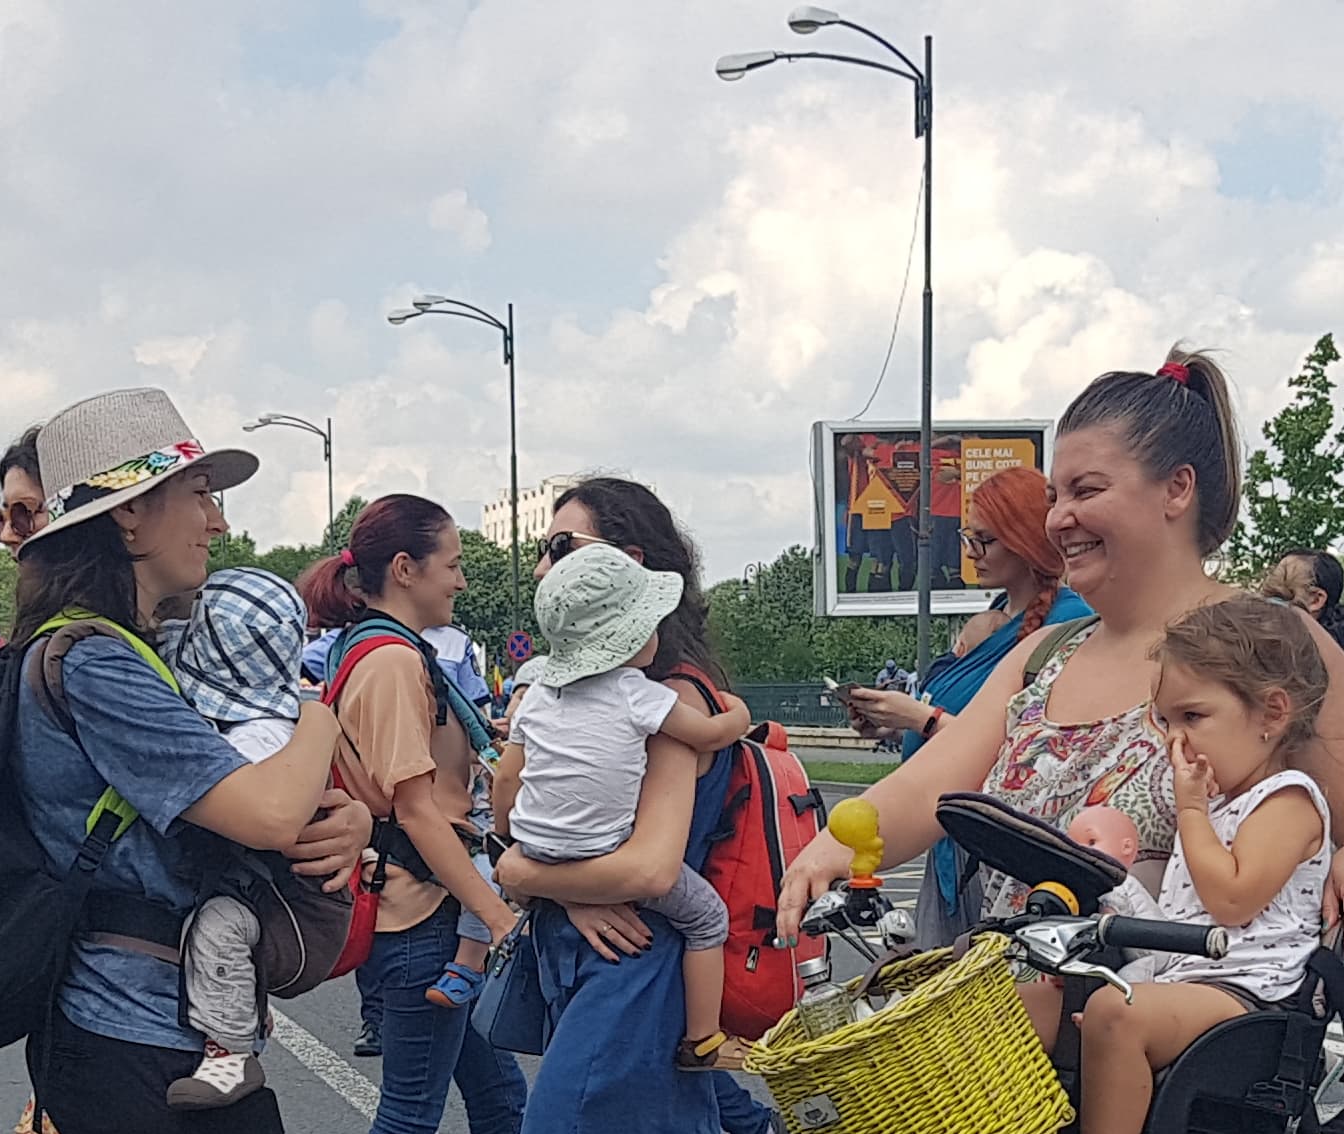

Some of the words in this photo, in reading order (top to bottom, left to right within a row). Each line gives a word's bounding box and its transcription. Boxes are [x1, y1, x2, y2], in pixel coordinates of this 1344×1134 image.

[965, 448, 992, 458] CELE
[993, 447, 1013, 458] MAI
[965, 460, 993, 470] BUNE
